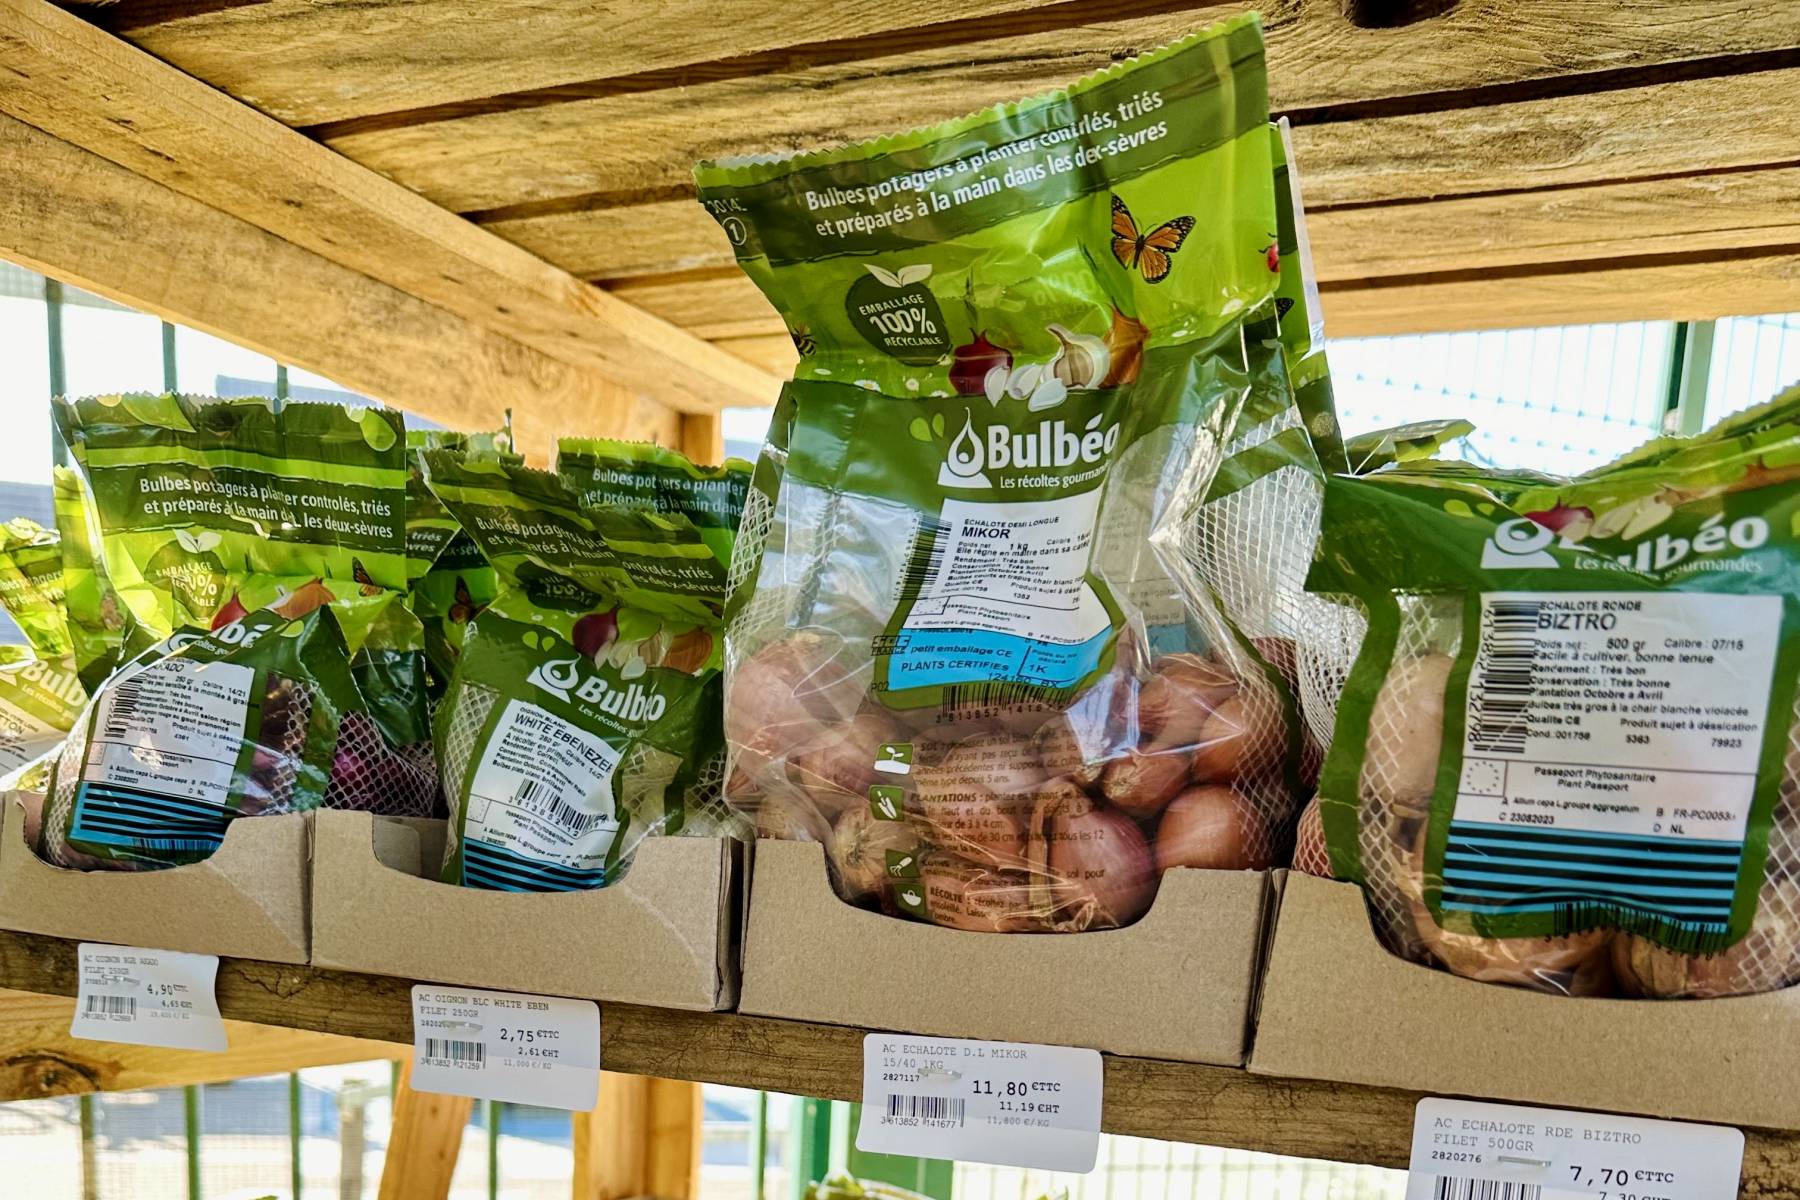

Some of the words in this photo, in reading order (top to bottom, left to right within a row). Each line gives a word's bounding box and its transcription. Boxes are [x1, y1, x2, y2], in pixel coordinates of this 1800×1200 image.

[806, 188, 864, 211] Bulbes
[867, 162, 953, 203] potagers
[956, 158, 968, 173] à
[971, 138, 1037, 174] planter
[1118, 91, 1163, 121] triés
[816, 220, 834, 237] et
[836, 201, 913, 238] préparés
[918, 197, 928, 216] à
[931, 192, 949, 213] la
[954, 177, 999, 205] main
[1004, 164, 1046, 189] dans
[1050, 155, 1073, 175] les
[858, 292, 925, 316] EMBALLAGE
[869, 304, 937, 337] 100%
[884, 333, 944, 347] RECYCLABLE
[593, 469, 634, 486] Bulbes
[693, 480, 745, 495] planter
[1000, 476, 1014, 488] Les
[1018, 475, 1060, 488] récoltes
[140, 476, 191, 494] Bulbes
[193, 479, 248, 498] potagers
[250, 482, 258, 497] à
[361, 499, 391, 517] triés
[681, 499, 708, 512] main
[712, 502, 744, 516] dans
[144, 499, 160, 513] et
[163, 499, 222, 519] préparés
[247, 505, 279, 521] main
[303, 511, 323, 529] les
[324, 514, 393, 539] deux-sèvres
[1008, 520, 1027, 528] DEMI
[1029, 517, 1059, 526] LONGUE
[962, 527, 1010, 540] MIKOR
[682, 567, 713, 580] triés
[1538, 613, 1616, 631] BIZTRO
[1607, 638, 1628, 649] 500
[1664, 637, 1702, 649] Calibre
[911, 644, 936, 655] petit
[938, 646, 992, 656] emballage
[996, 648, 1012, 658] CE
[1533, 650, 1566, 661] Facile
[1636, 652, 1675, 663] bonne
[1678, 653, 1714, 664] tenue
[901, 660, 944, 672] PLANTS
[950, 660, 1009, 672] CERTIFIES
[1600, 665, 1622, 675] Très
[1626, 665, 1646, 676] bon
[1529, 677, 1601, 688] Conservation
[1611, 678, 1634, 688] Très
[1636, 678, 1671, 689] bonne
[1584, 689, 1625, 699] Octobre
[1637, 690, 1663, 700] Avril
[579, 704, 592, 716] Les
[1631, 704, 1657, 714] chair
[1660, 705, 1701, 716] blanche
[1705, 706, 1749, 718] violacée
[514, 713, 551, 735] WHITE
[1621, 719, 1657, 729] Produit
[1660, 721, 1686, 733] sujet
[1535, 766, 1584, 780] Passeport
[1586, 768, 1656, 784] Phytosanitaire
[1558, 780, 1582, 789] Plant
[419, 994, 430, 1002] AC
[435, 995, 468, 1004] OIGNON
[473, 998, 489, 1006] BLC
[494, 1000, 522, 1009] WHITE
[527, 1002, 549, 1011] EBEN
[420, 1007, 447, 1016] FILET
[452, 1009, 478, 1017] 250GR
[500, 1029, 534, 1042] 2,75
[537, 1029, 559, 1039] €TTC
[518, 1047, 539, 1057] 2,61
[542, 1049, 559, 1058] €HT
[883, 1044, 896, 1053] AC
[903, 1045, 956, 1056] ECHALOTE
[992, 1049, 1027, 1059] MIKOR
[883, 1058, 916, 1068] 15/40
[972, 1080, 1028, 1098] 11,80
[1031, 1082, 1061, 1092] €TTC
[999, 1101, 1035, 1112] 11,19
[1038, 1103, 1060, 1114] €HT
[1434, 1118, 1453, 1129] AC
[1461, 1120, 1535, 1135] ECHALOTE
[1545, 1126, 1573, 1139] RDE
[1583, 1130, 1642, 1144] BIZTRO
[1433, 1134, 1478, 1148] FILET
[1488, 1137, 1534, 1152] 500GR
[1432, 1151, 1482, 1164] 2820276
[1569, 1165, 1629, 1188] 7,70
[1634, 1170, 1674, 1183] €TTC
